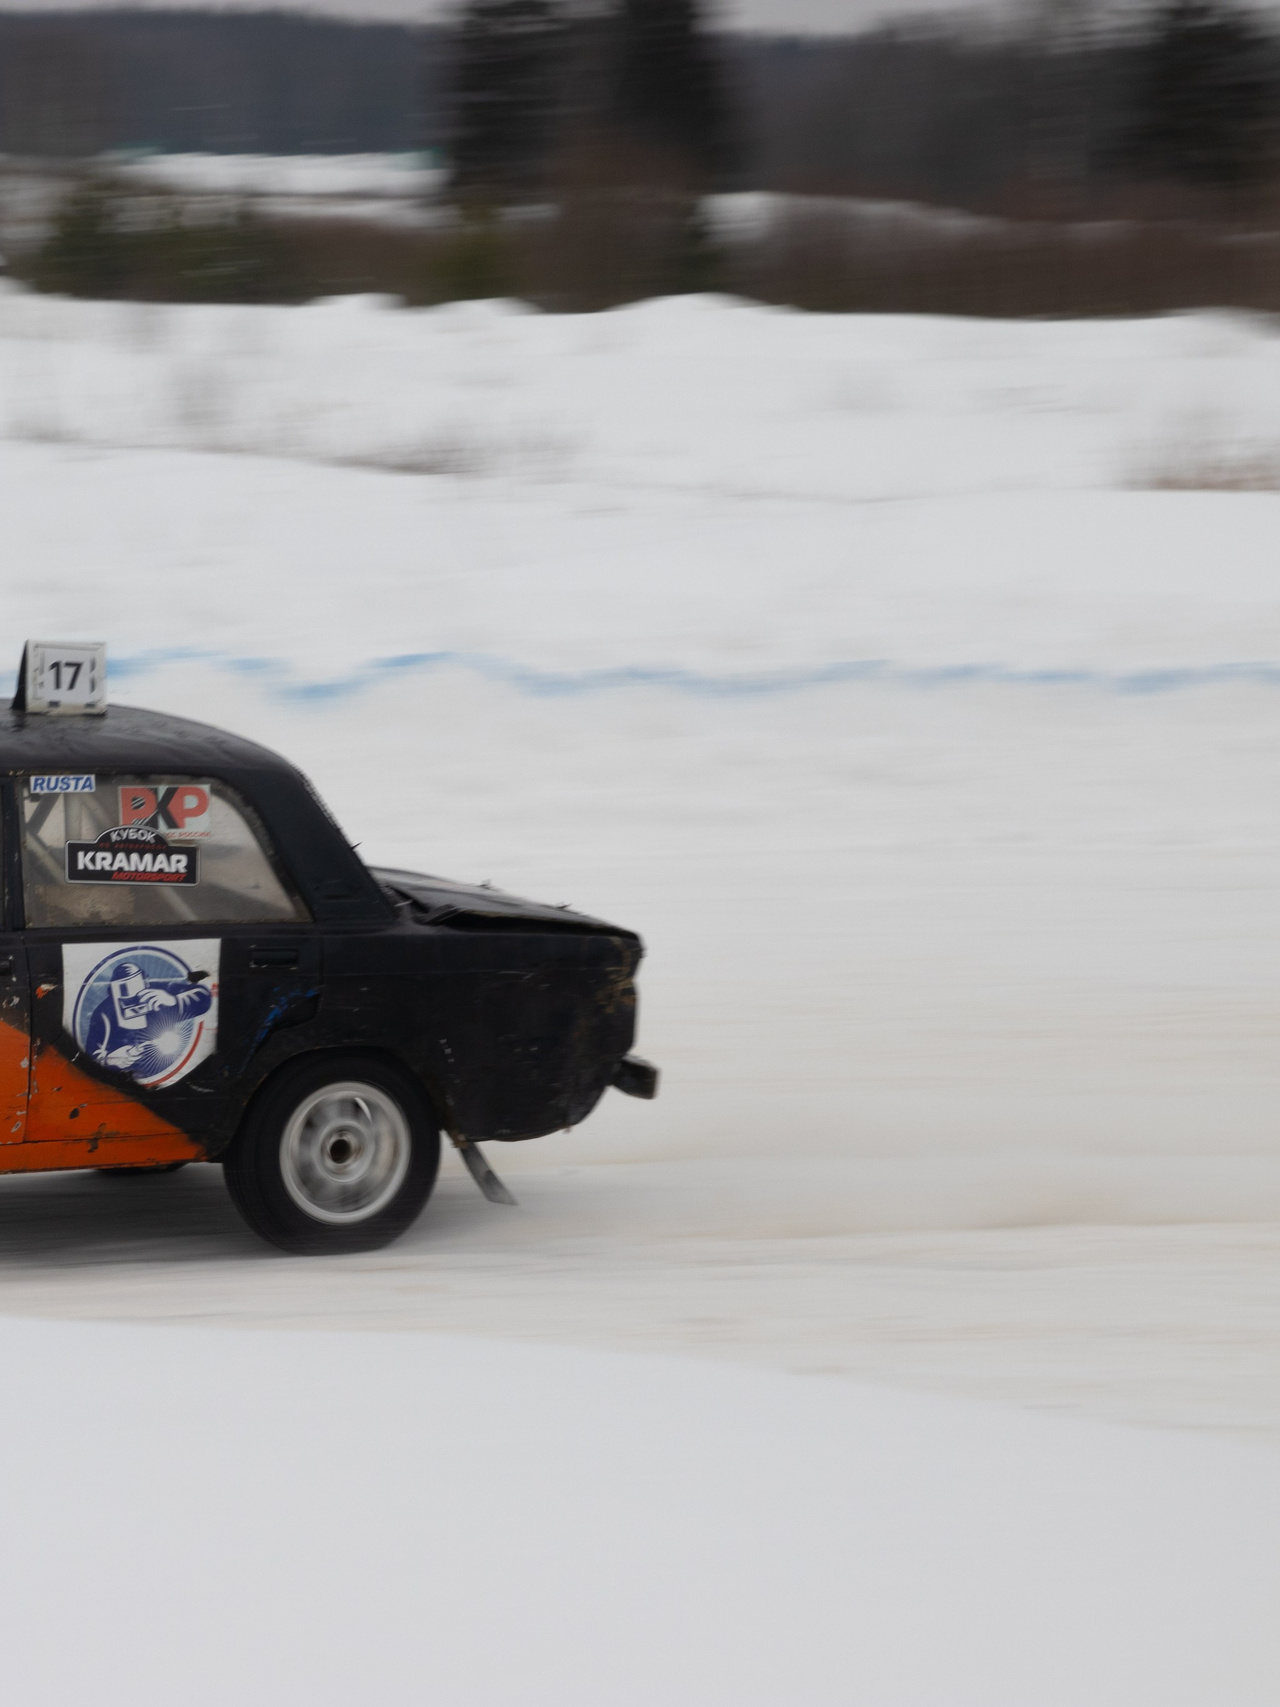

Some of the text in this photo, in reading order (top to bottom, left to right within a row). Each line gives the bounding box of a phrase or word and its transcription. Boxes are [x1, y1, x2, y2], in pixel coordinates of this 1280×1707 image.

[48, 661, 84, 691] 17
[33, 776, 94, 791] RUSTA
[110, 828, 156, 844] КУБОК
[77, 850, 188, 873] KRAMAR
[111, 871, 187, 882] MOTORSPORT
